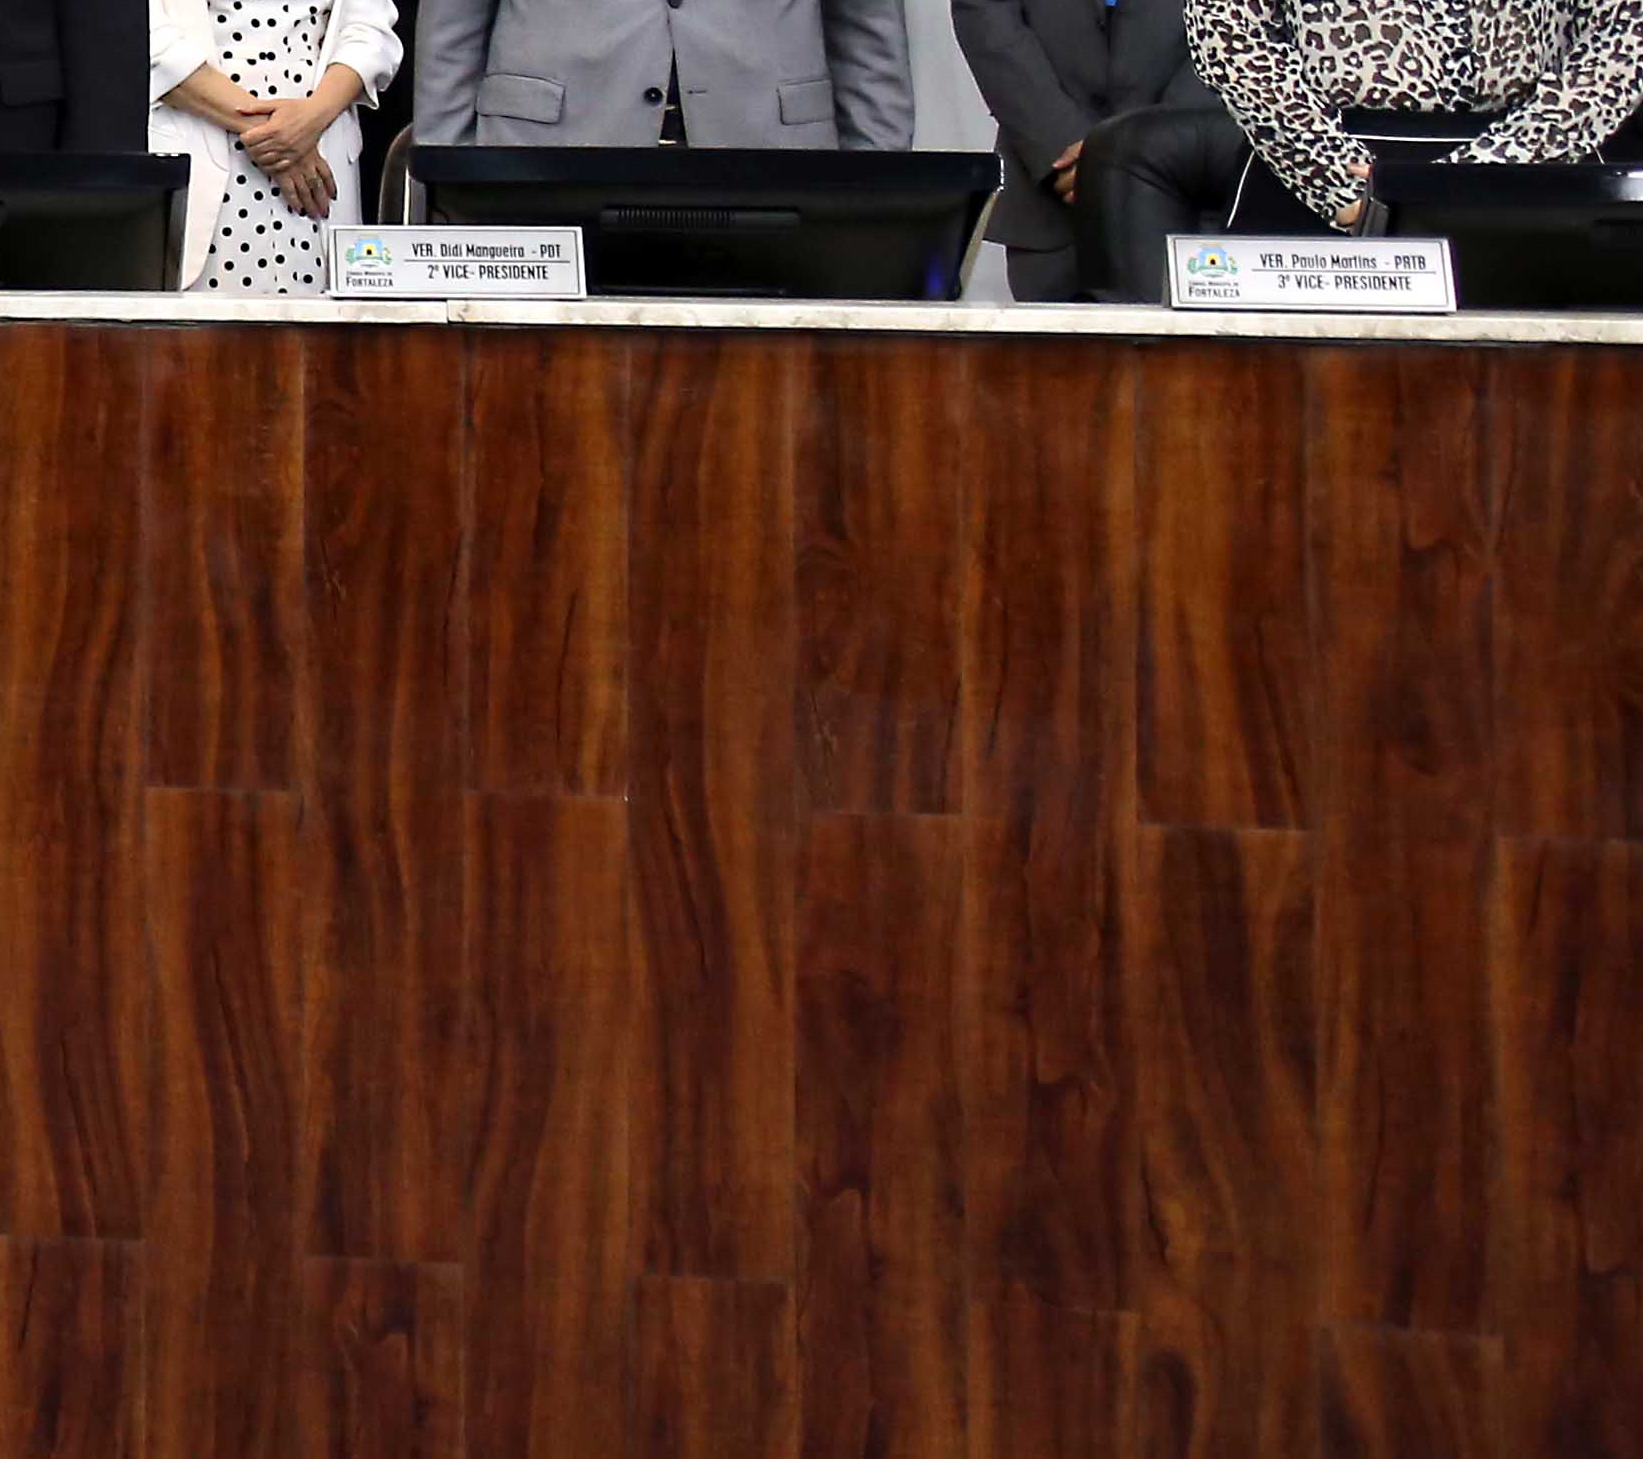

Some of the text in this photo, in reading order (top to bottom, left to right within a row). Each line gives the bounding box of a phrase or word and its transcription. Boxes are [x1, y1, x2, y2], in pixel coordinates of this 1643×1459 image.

[412, 243, 437, 258] VER.
[440, 243, 463, 258] Didi
[466, 244, 525, 260] Mangueira
[540, 244, 562, 259] PDT
[1259, 253, 1288, 269] VER.
[1331, 254, 1378, 270] Martins
[1394, 255, 1427, 271] PRTB
[479, 264, 549, 281] PRESIDENTE
[345, 275, 394, 288] FORTALEZA
[1334, 274, 1413, 292] PRESIDENTE
[1187, 285, 1241, 298] FORTALEZA
